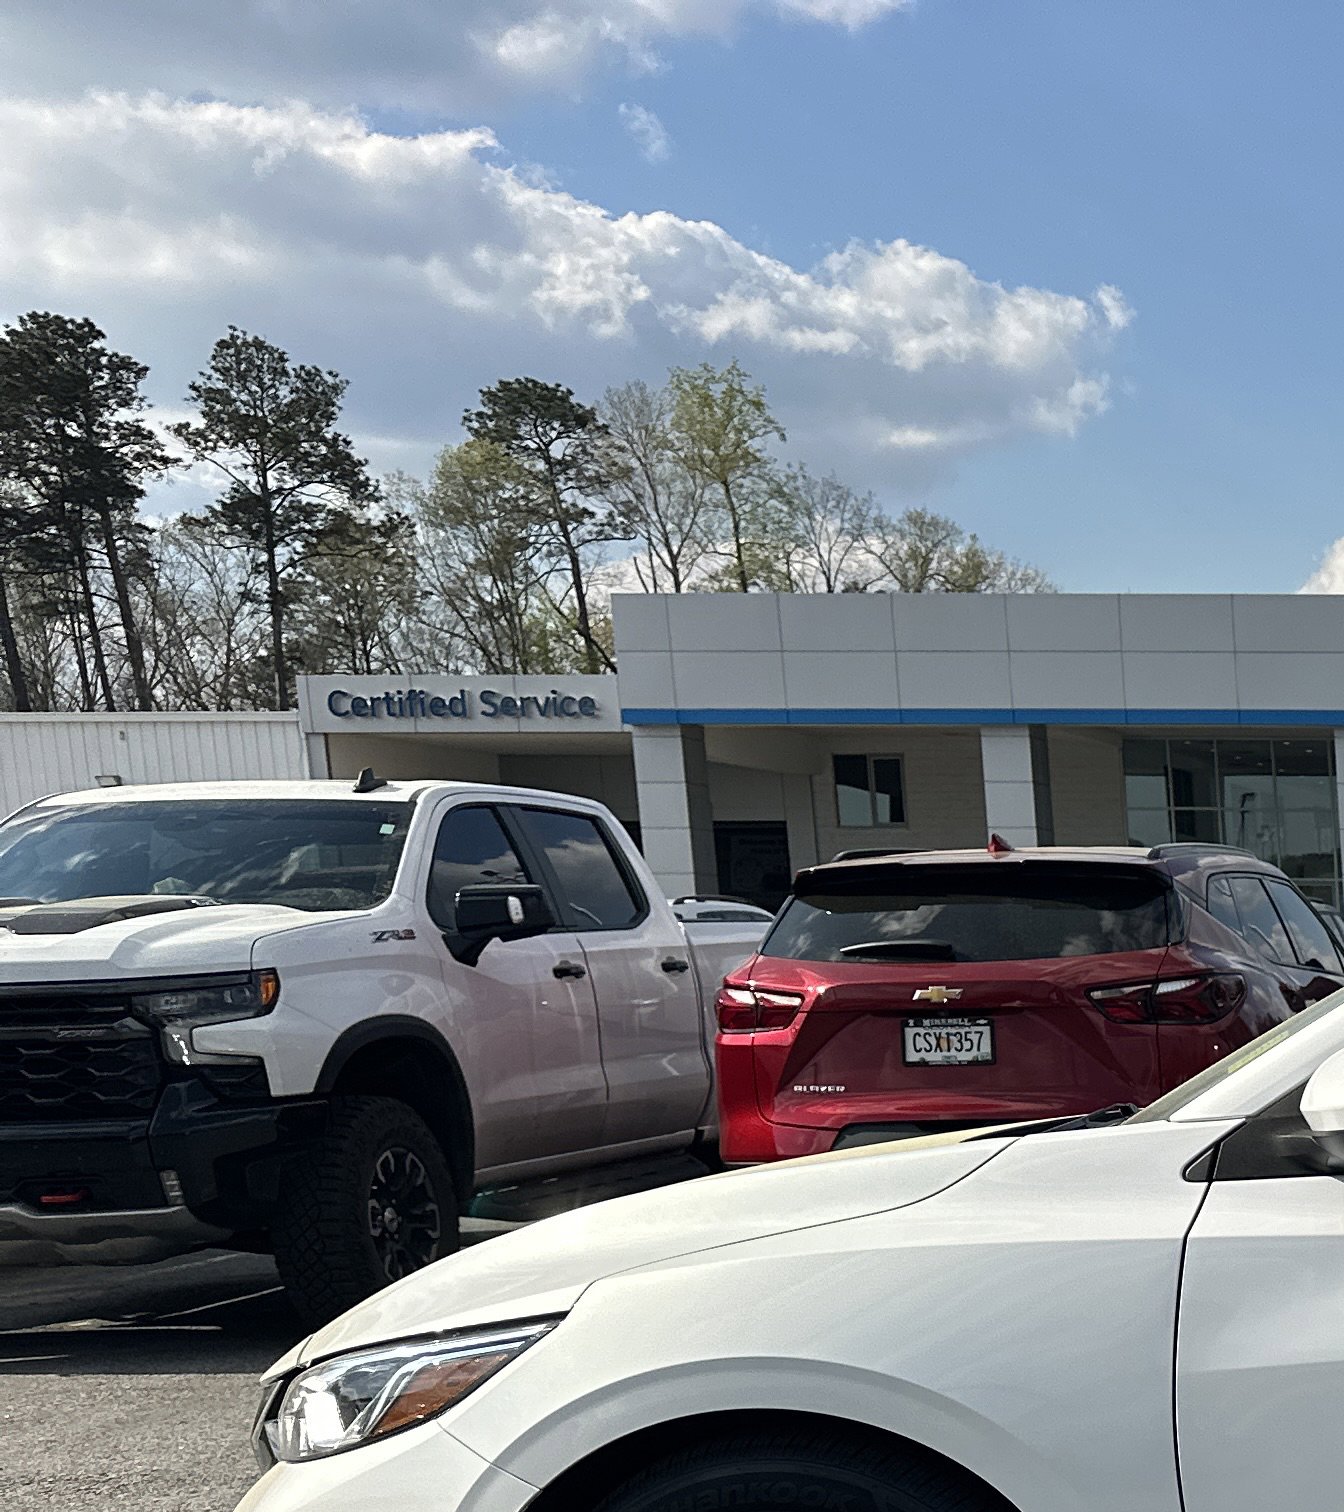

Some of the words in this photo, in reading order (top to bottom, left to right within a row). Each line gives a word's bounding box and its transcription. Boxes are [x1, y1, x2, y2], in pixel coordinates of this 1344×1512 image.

[327, 689, 467, 718] Certified
[480, 689, 597, 718] Service
[793, 1085, 846, 1093] BLAZER
